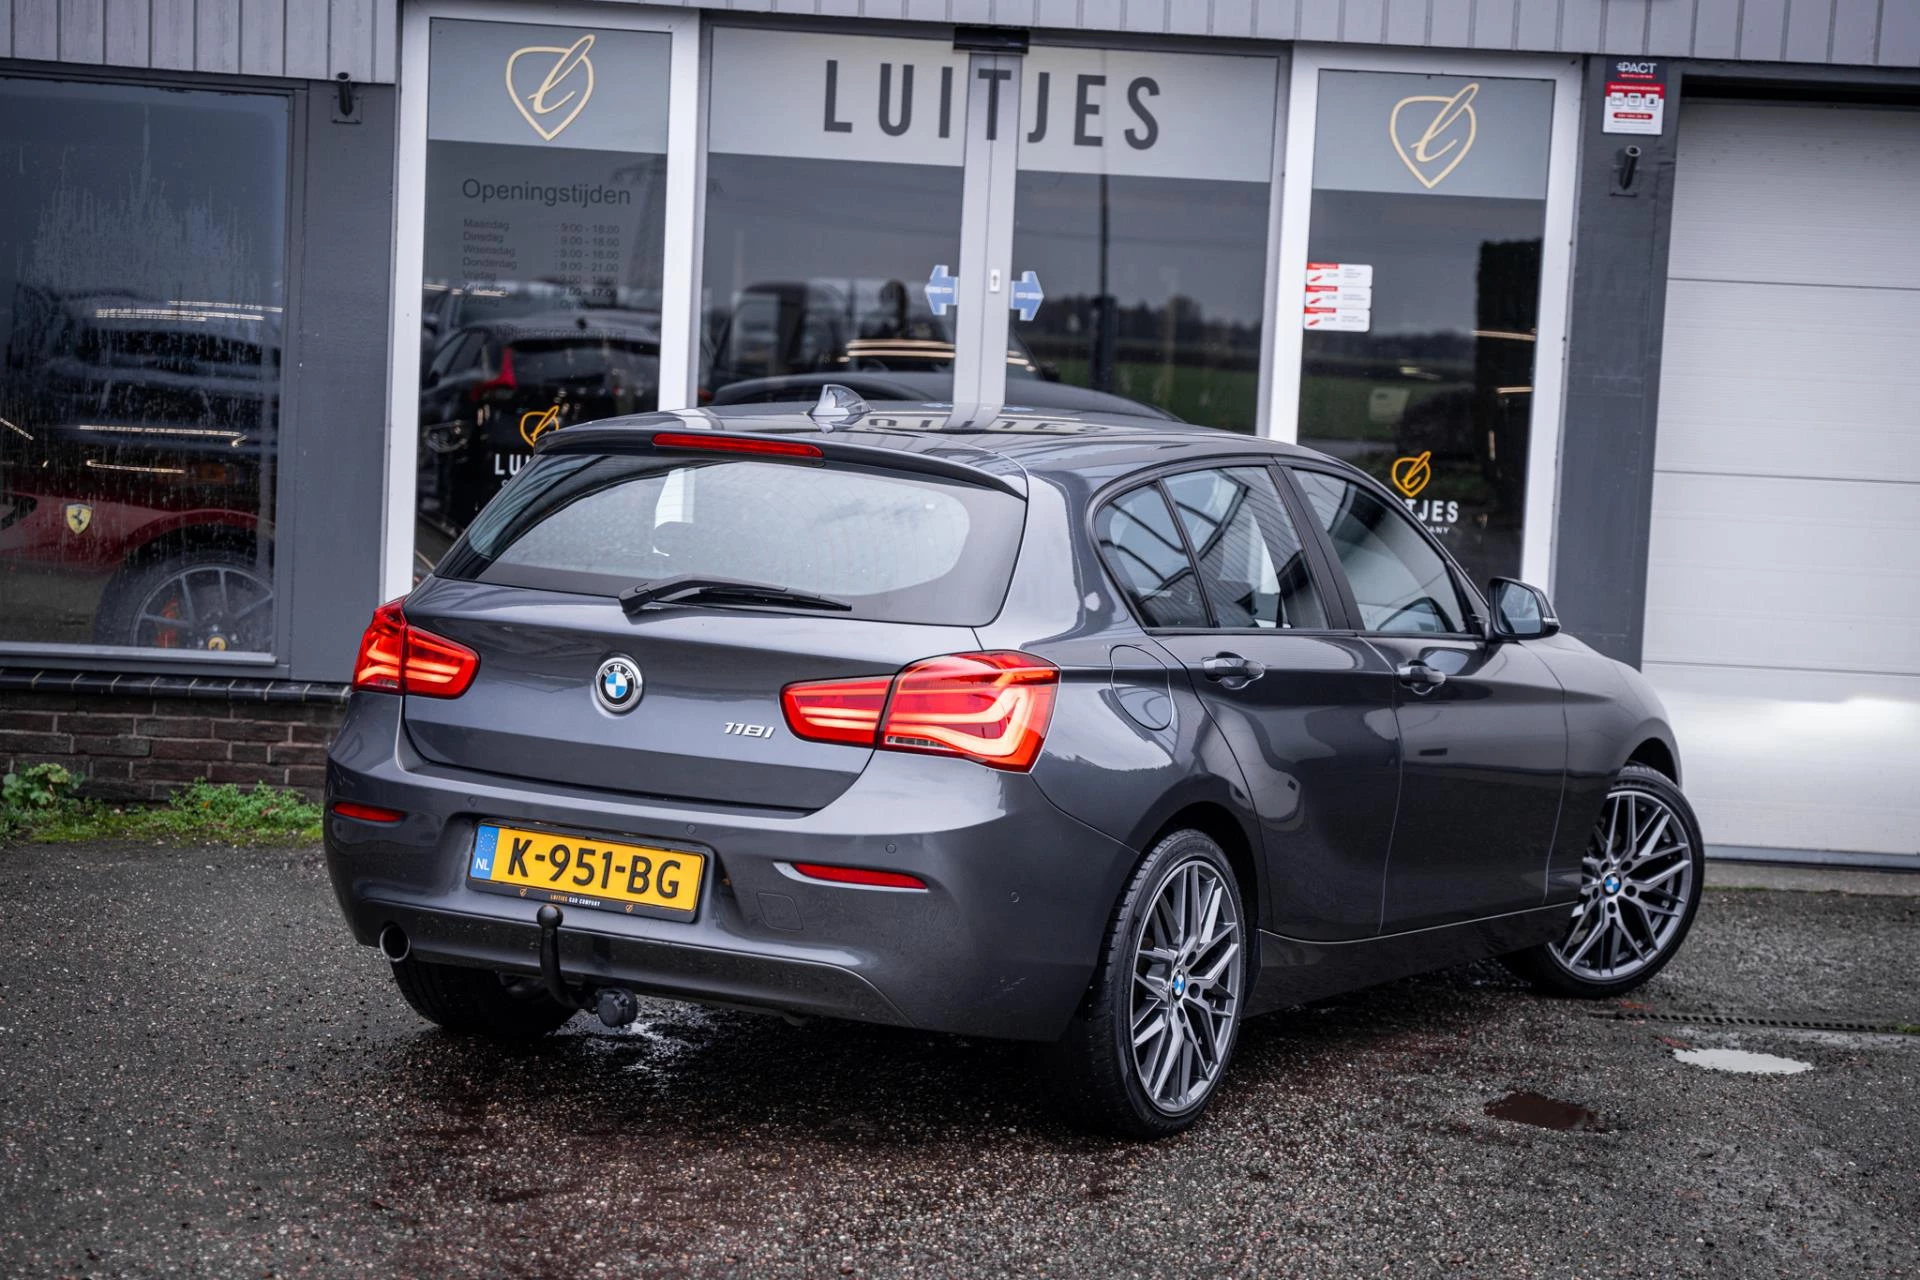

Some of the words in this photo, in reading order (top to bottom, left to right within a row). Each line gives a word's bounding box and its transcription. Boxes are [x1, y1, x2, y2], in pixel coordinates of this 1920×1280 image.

[824, 60, 1160, 150] LUITJES
[462, 178, 631, 208] Openingstijden
[1404, 498, 1459, 523] TJES
[475, 857, 490, 871] NL
[507, 837, 681, 899] K-951-BG
